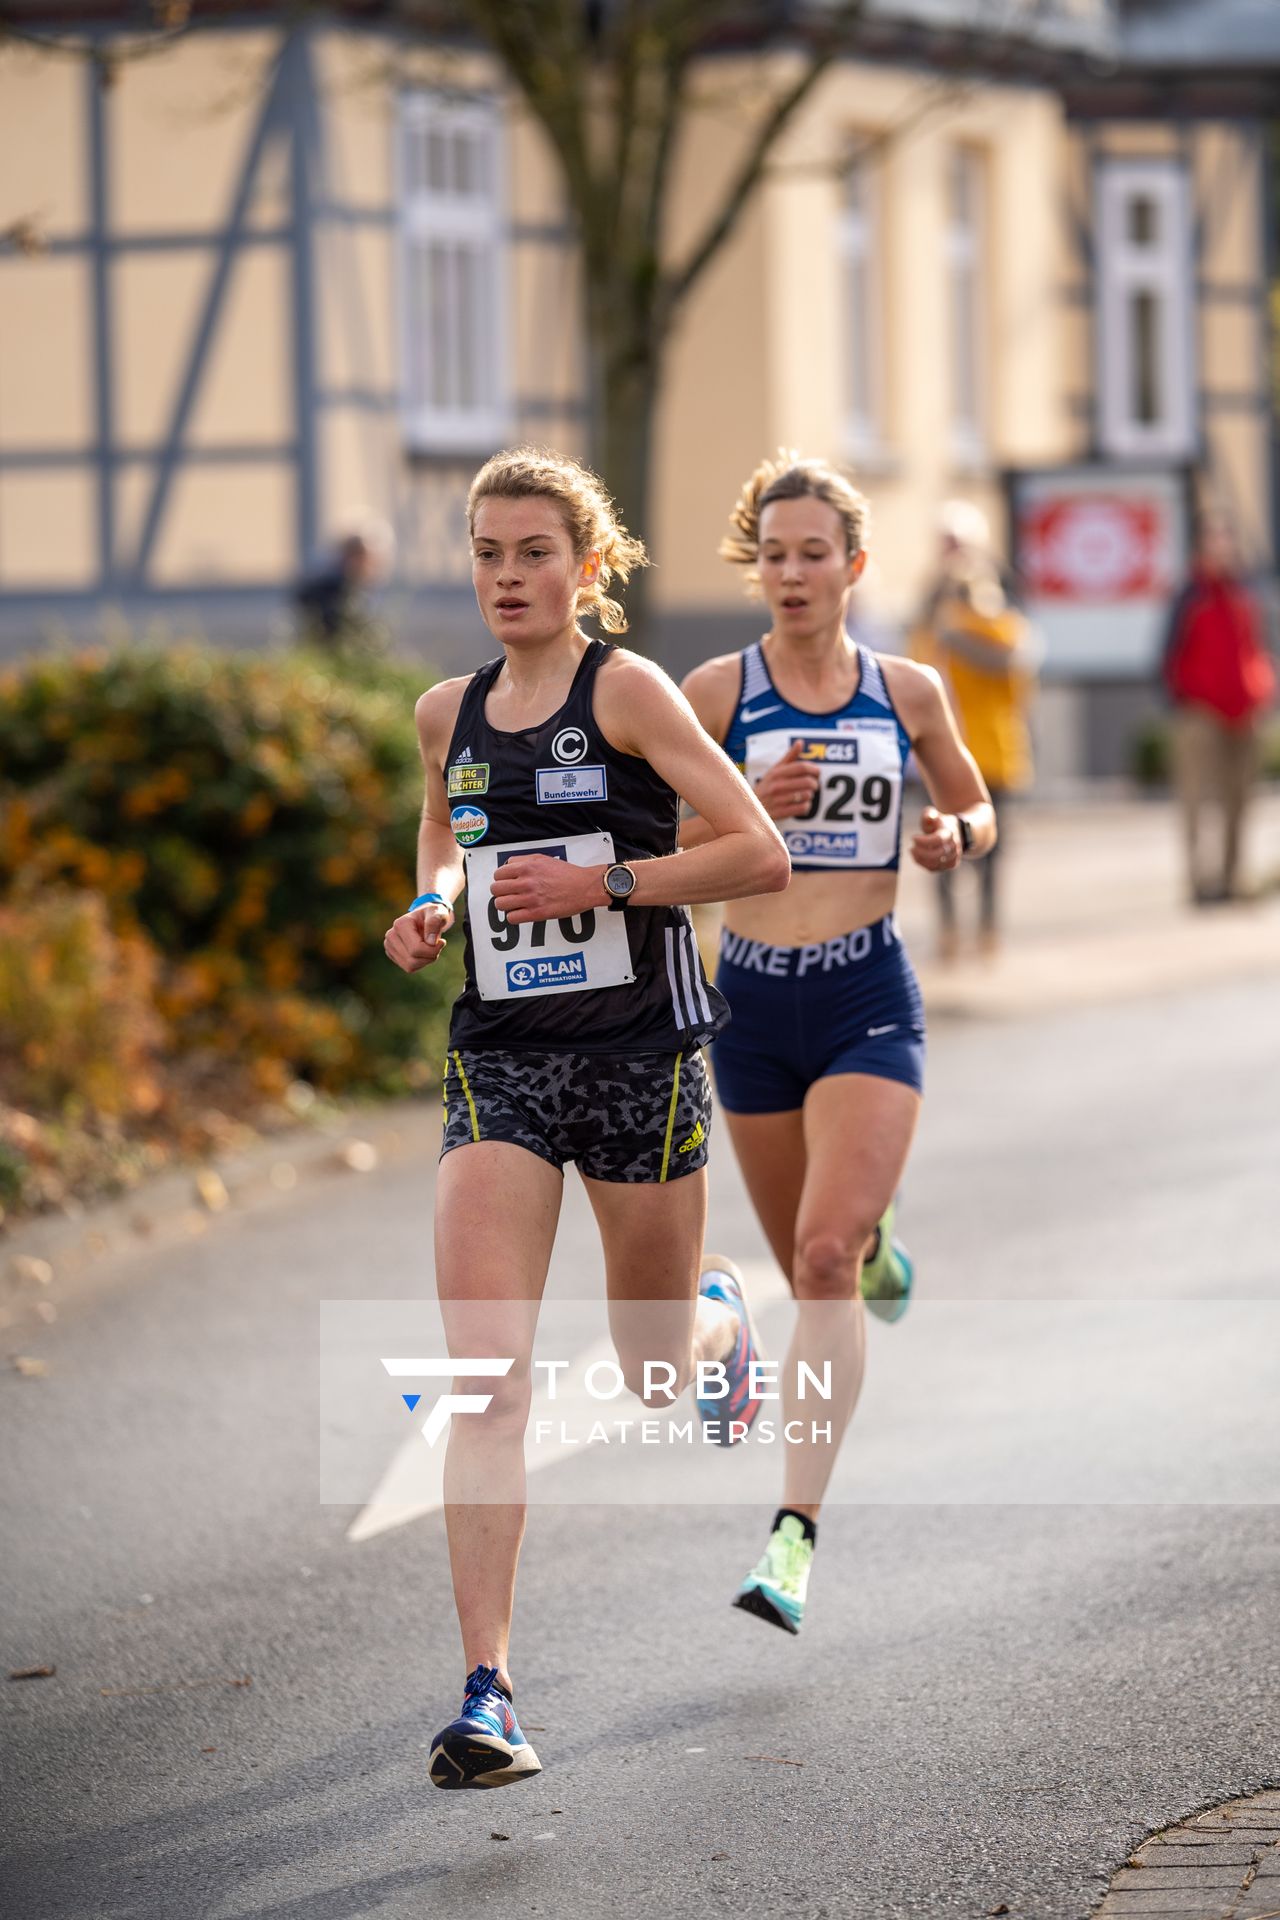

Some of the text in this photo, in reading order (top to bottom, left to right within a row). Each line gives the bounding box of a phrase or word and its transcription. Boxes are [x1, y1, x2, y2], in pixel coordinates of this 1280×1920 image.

[826, 743, 855, 761] GLS
[455, 756, 473, 765] adidas
[456, 769, 477, 780] BURG
[543, 788, 599, 799] Bundeswehr
[721, 930, 793, 977] NIKE
[796, 927, 873, 977] PRO
[537, 959, 582, 976] PLAN
[539, 974, 584, 984] INTERNATIONAL
